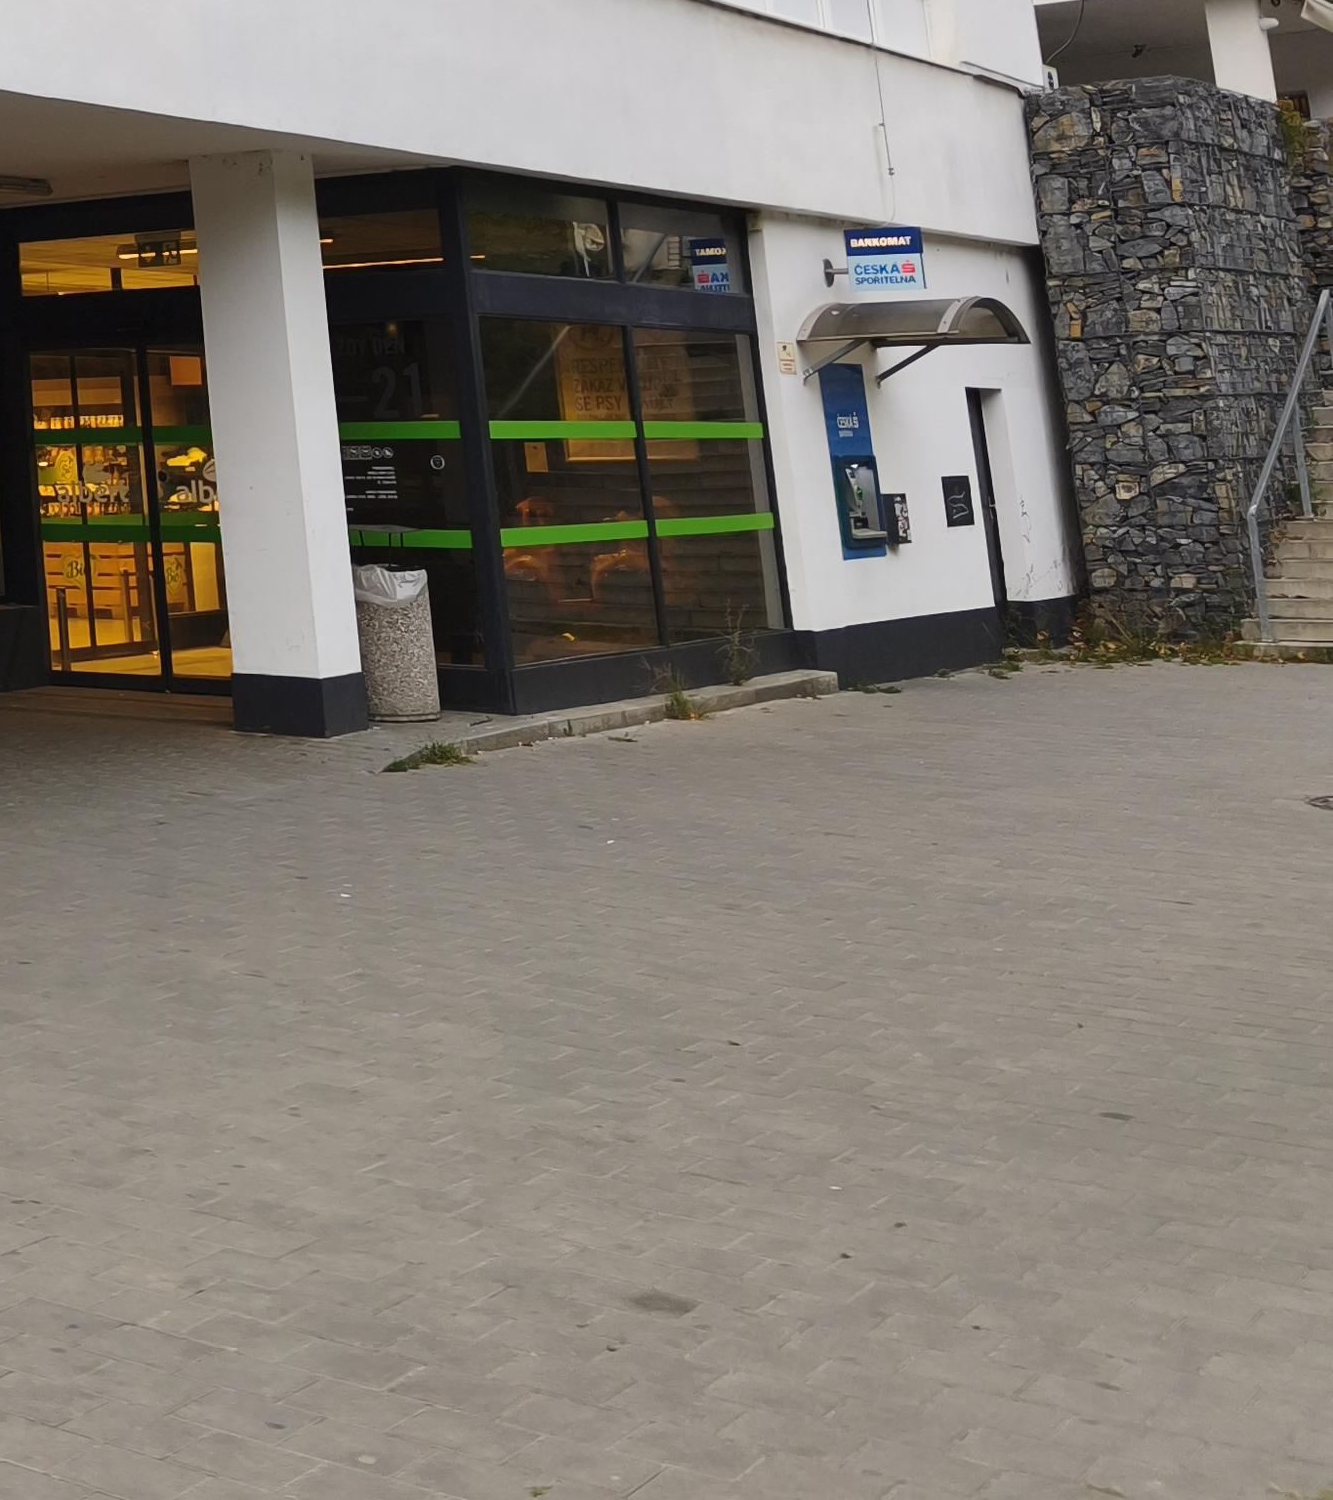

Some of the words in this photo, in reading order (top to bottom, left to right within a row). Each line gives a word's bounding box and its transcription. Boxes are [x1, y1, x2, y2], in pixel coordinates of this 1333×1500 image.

[849, 235, 912, 248] BANKOMAT
[854, 261, 900, 276] ČESKÁ
[855, 275, 917, 285] SPOŘITELNA
[57, 474, 130, 503] albert
